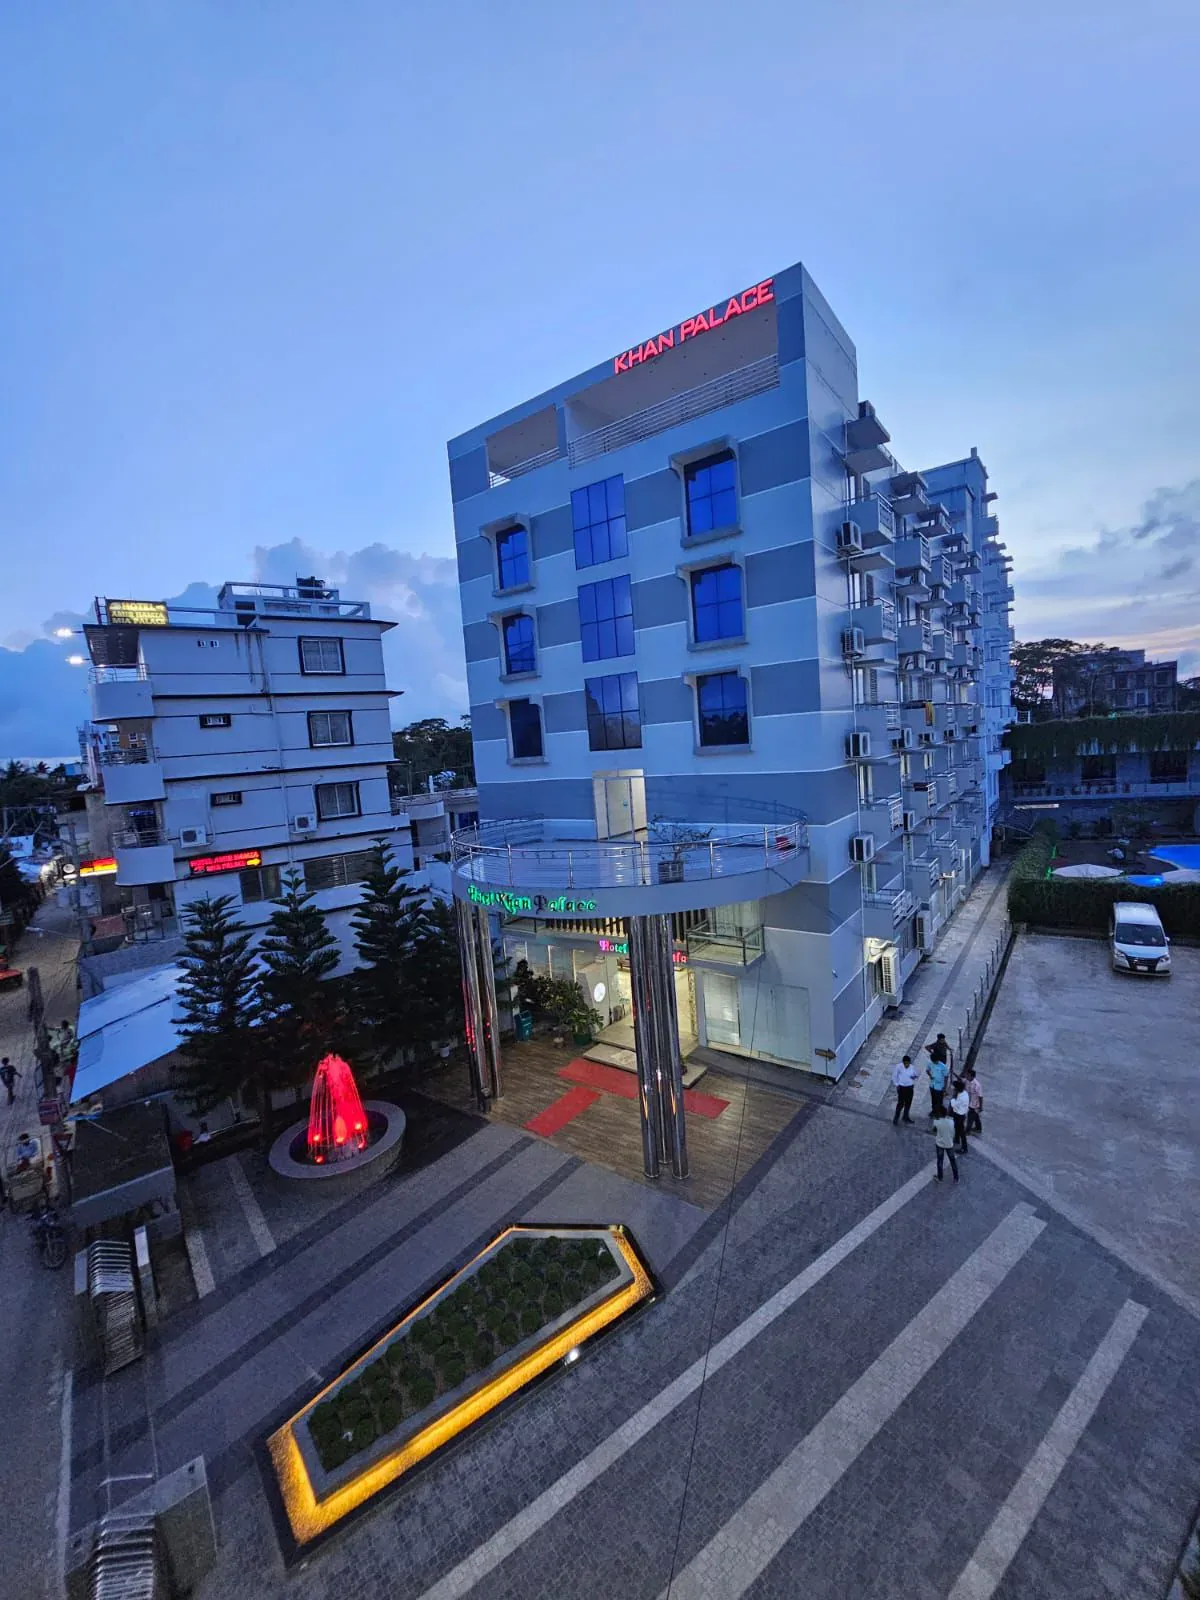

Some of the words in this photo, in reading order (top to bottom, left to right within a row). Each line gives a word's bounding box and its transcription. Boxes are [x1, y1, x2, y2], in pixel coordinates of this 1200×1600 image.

[614, 329, 675, 374] KHAN
[680, 278, 774, 341] PALACE
[534, 895, 598, 914] Palace
